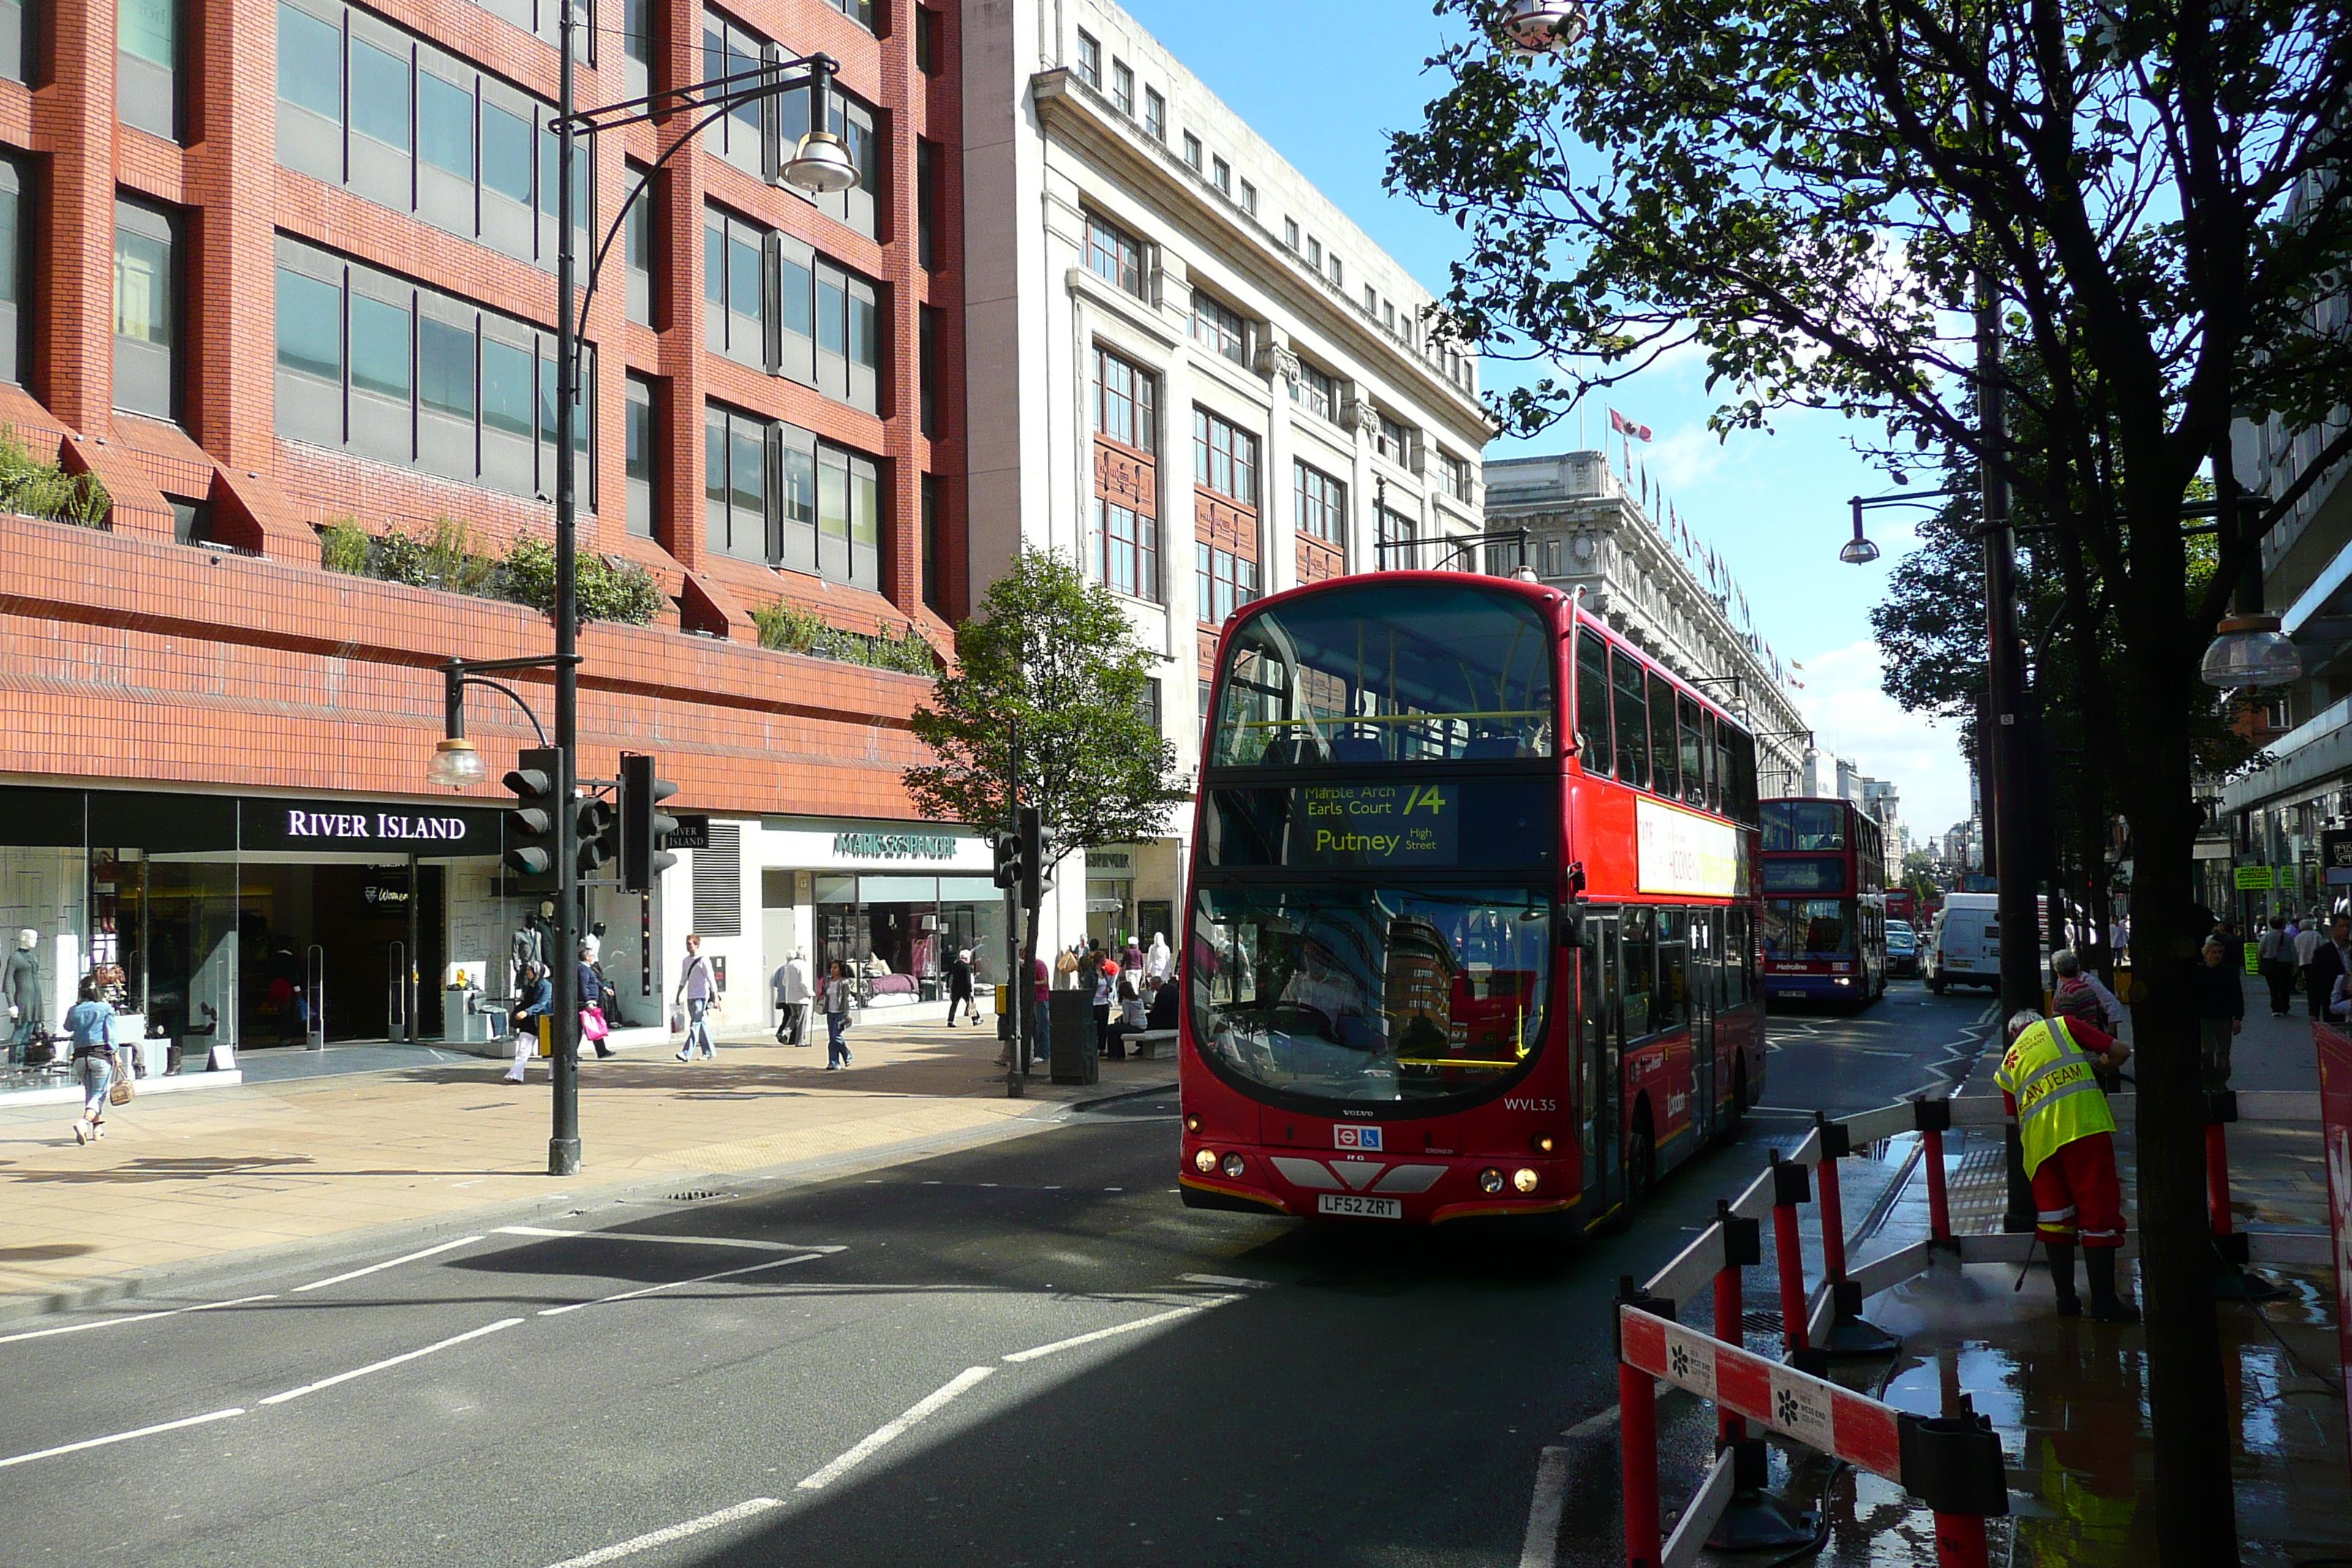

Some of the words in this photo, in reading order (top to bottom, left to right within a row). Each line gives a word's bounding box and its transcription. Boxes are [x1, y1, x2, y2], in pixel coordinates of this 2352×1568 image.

[1305, 786, 1354, 799] Marble
[1361, 785, 1395, 799] Arch
[1403, 784, 1447, 815] 74
[1308, 802, 1343, 816] Earls
[1349, 800, 1392, 815] Court
[288, 810, 370, 837] RIVER
[377, 813, 466, 840] ISLAND
[670, 826, 697, 836] RIVER
[1409, 828, 1433, 840] High
[669, 837, 704, 846] ISLAND
[1316, 829, 1401, 857] Putney
[1406, 840, 1437, 851] Street
[1776, 962, 1808, 971] Metroline
[2033, 1030, 2046, 1040] END
[2043, 1063, 2083, 1089] TEAM
[1504, 1097, 1556, 1112] WVL35
[1343, 1109, 1374, 1117] VOLVO
[1324, 1196, 1362, 1213] LF52
[1367, 1199, 1395, 1215] ZRT
[1814, 1410, 1825, 1420] END
